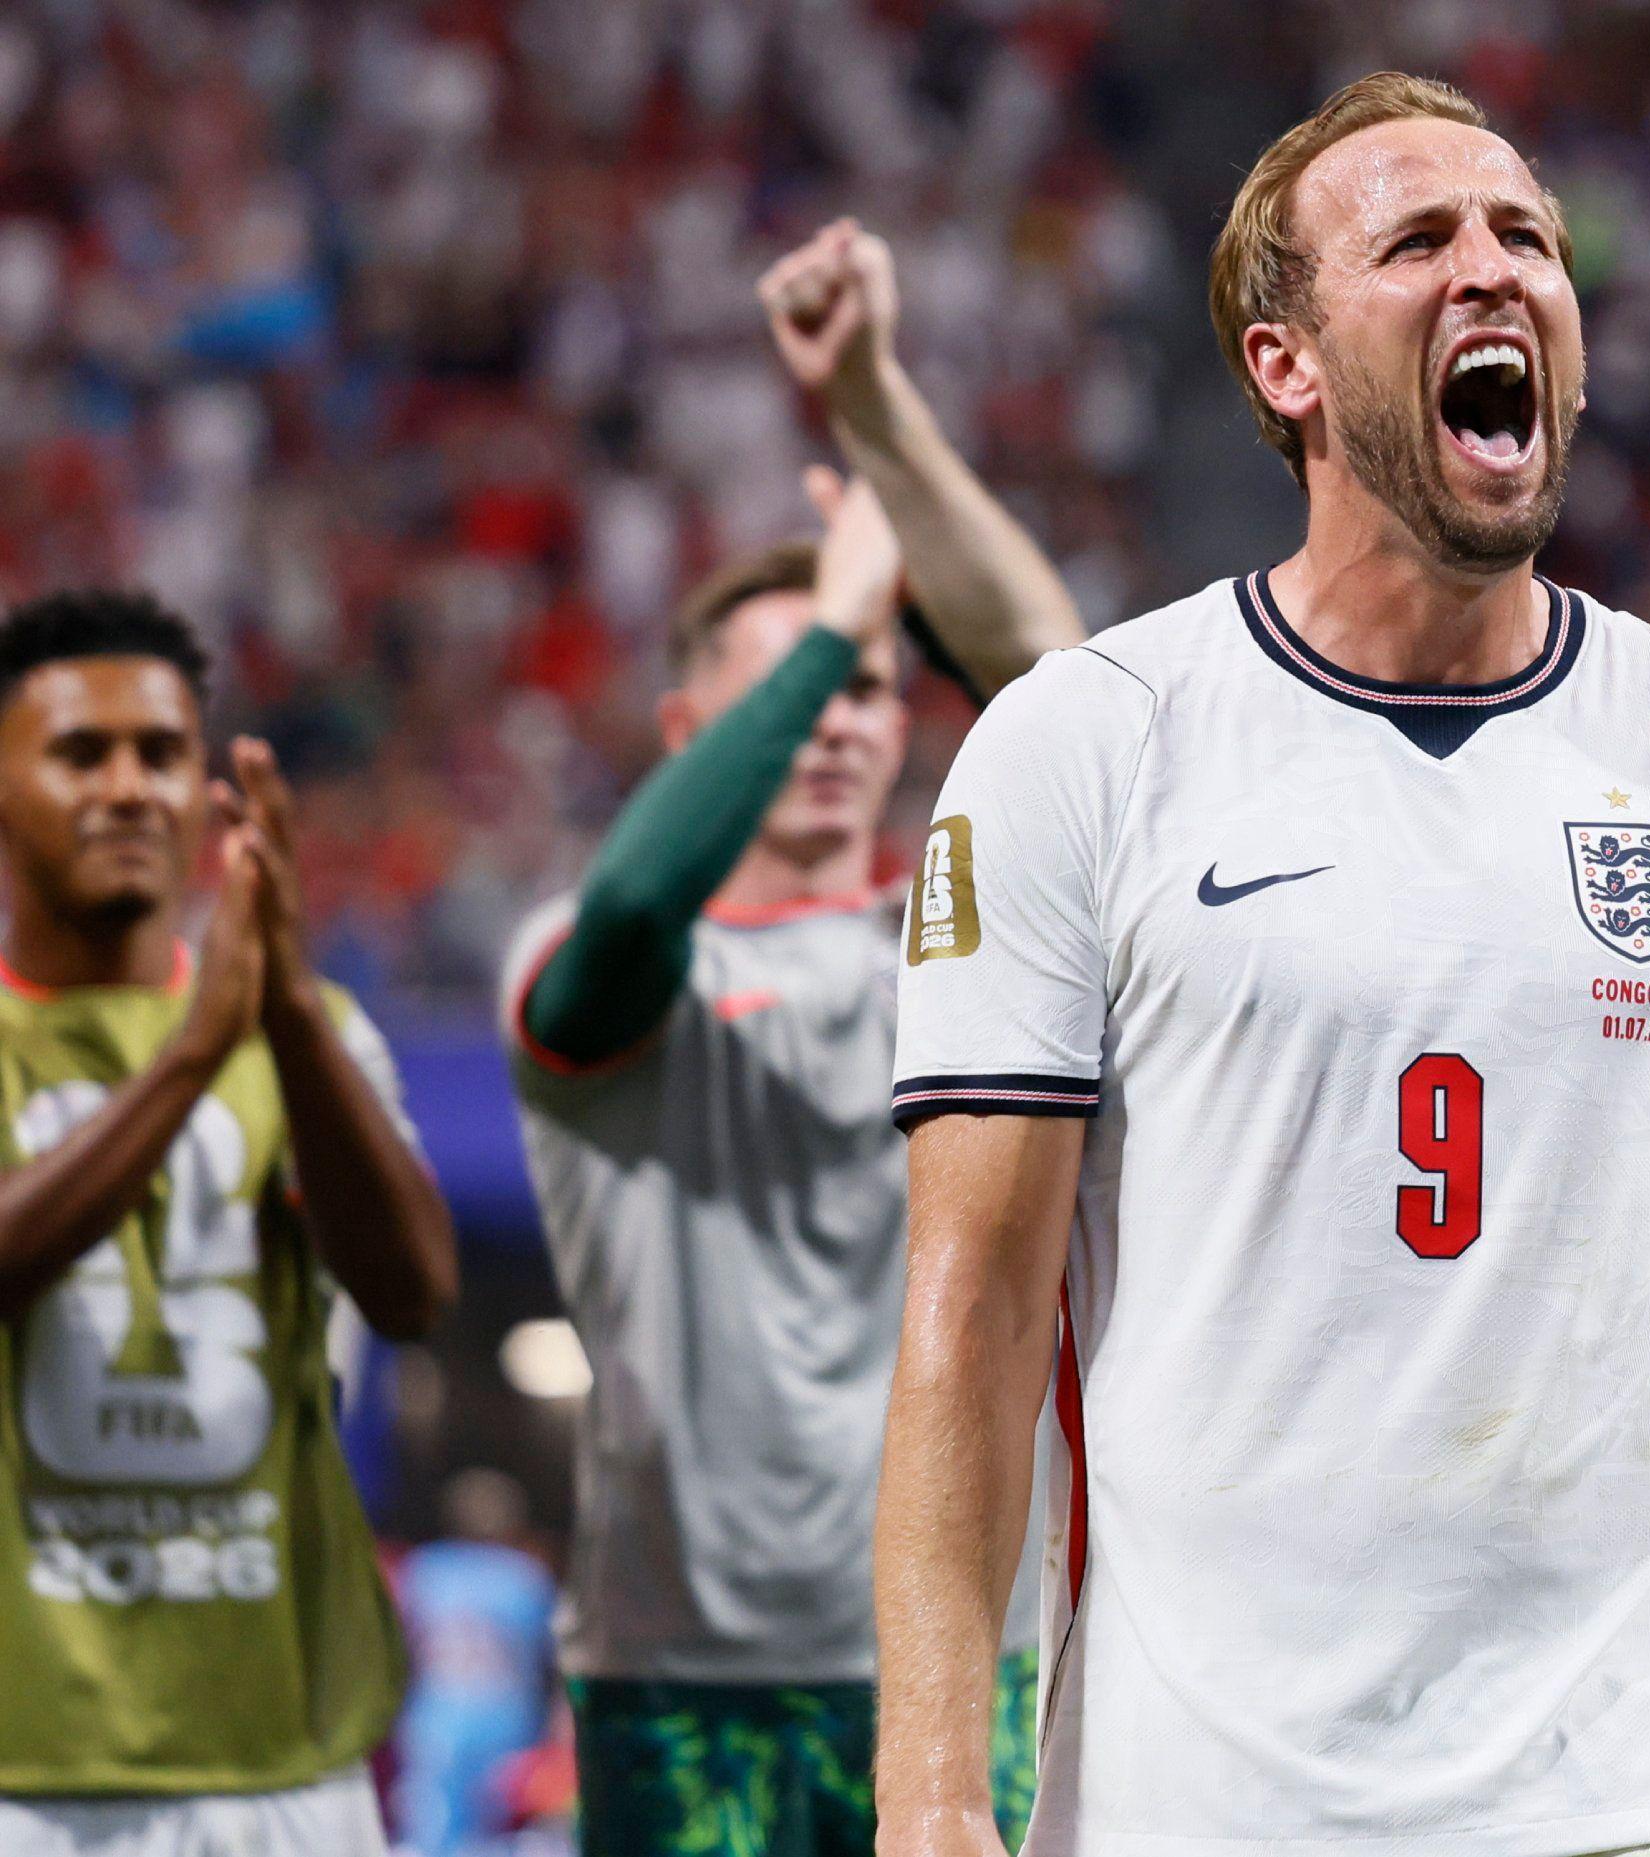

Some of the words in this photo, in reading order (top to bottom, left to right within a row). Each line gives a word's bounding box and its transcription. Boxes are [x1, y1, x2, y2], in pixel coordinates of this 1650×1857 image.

[921, 933, 956, 953] 026
[937, 923, 955, 933] CUP
[1396, 1052, 1485, 1260] 9
[28, 1537, 281, 1603] 2026
